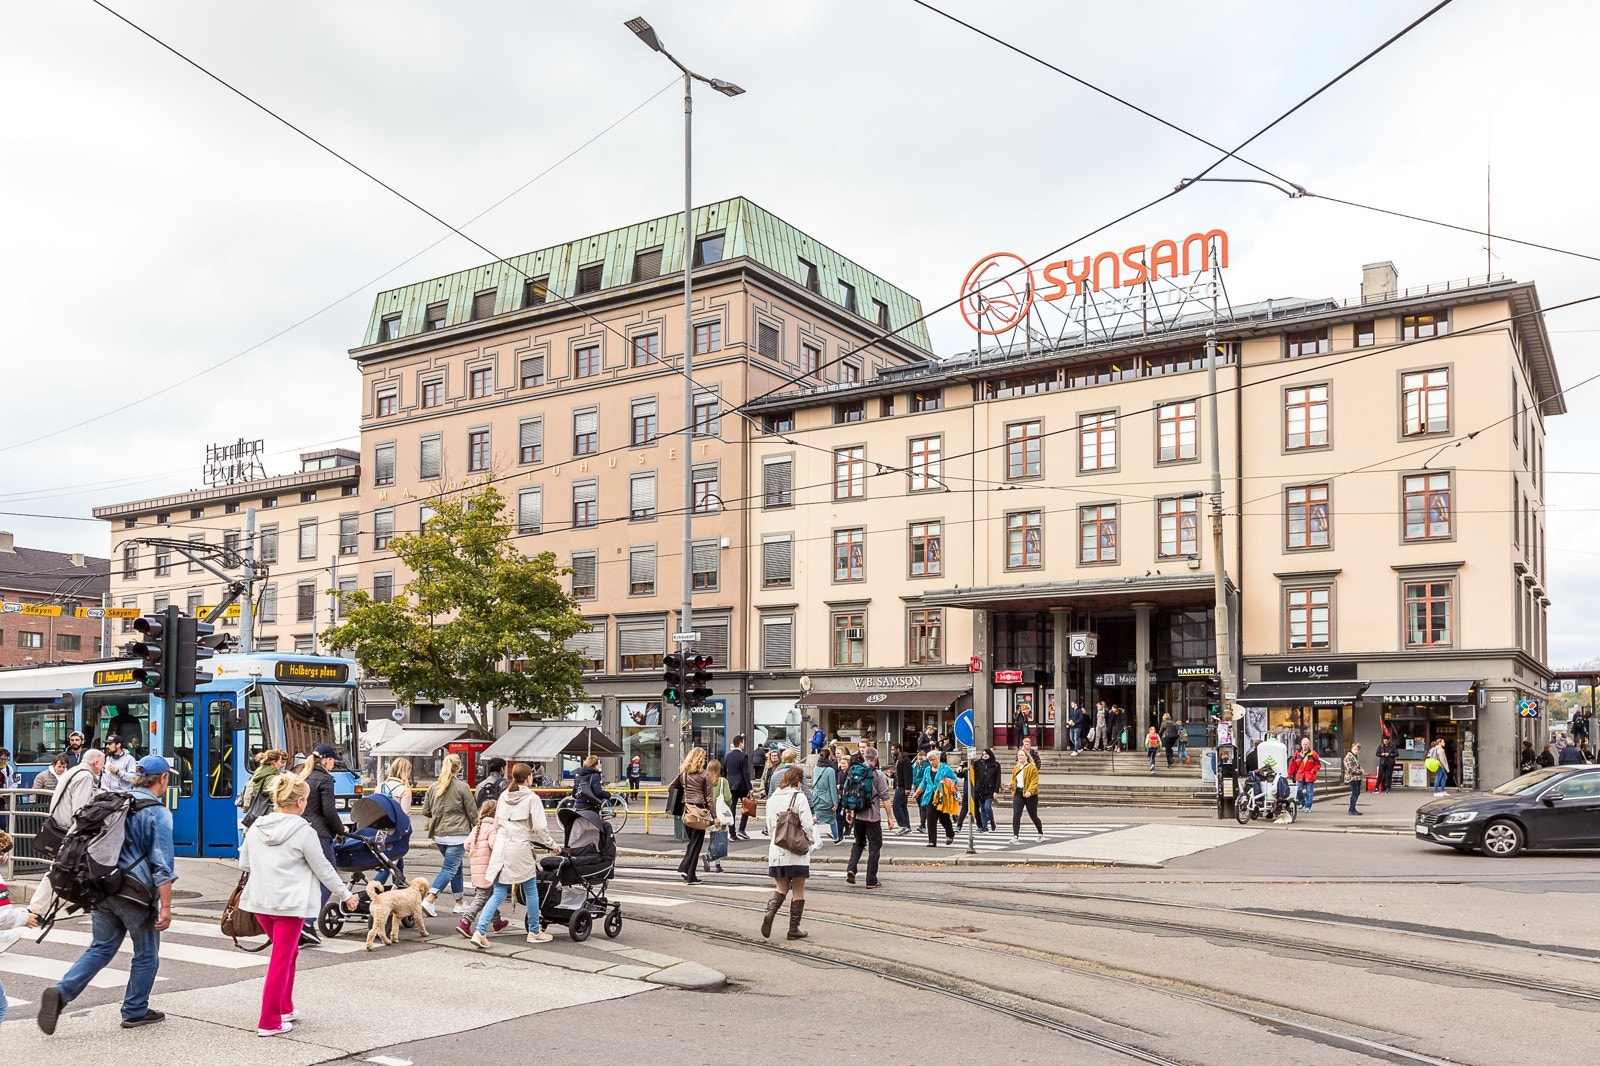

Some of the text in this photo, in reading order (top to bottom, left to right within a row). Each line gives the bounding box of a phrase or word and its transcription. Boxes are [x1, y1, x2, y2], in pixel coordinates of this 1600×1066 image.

[1043, 228, 1229, 302] SYNSAM
[107, 610, 133, 618] Skøyen
[290, 664, 318, 678] Holbergs
[319, 665, 337, 678] plass
[1287, 665, 1329, 673] CHANGE
[853, 676, 922, 688] W. B. SAMSON
[1383, 695, 1447, 703] MAJOREN
[691, 704, 715, 713] ordea
